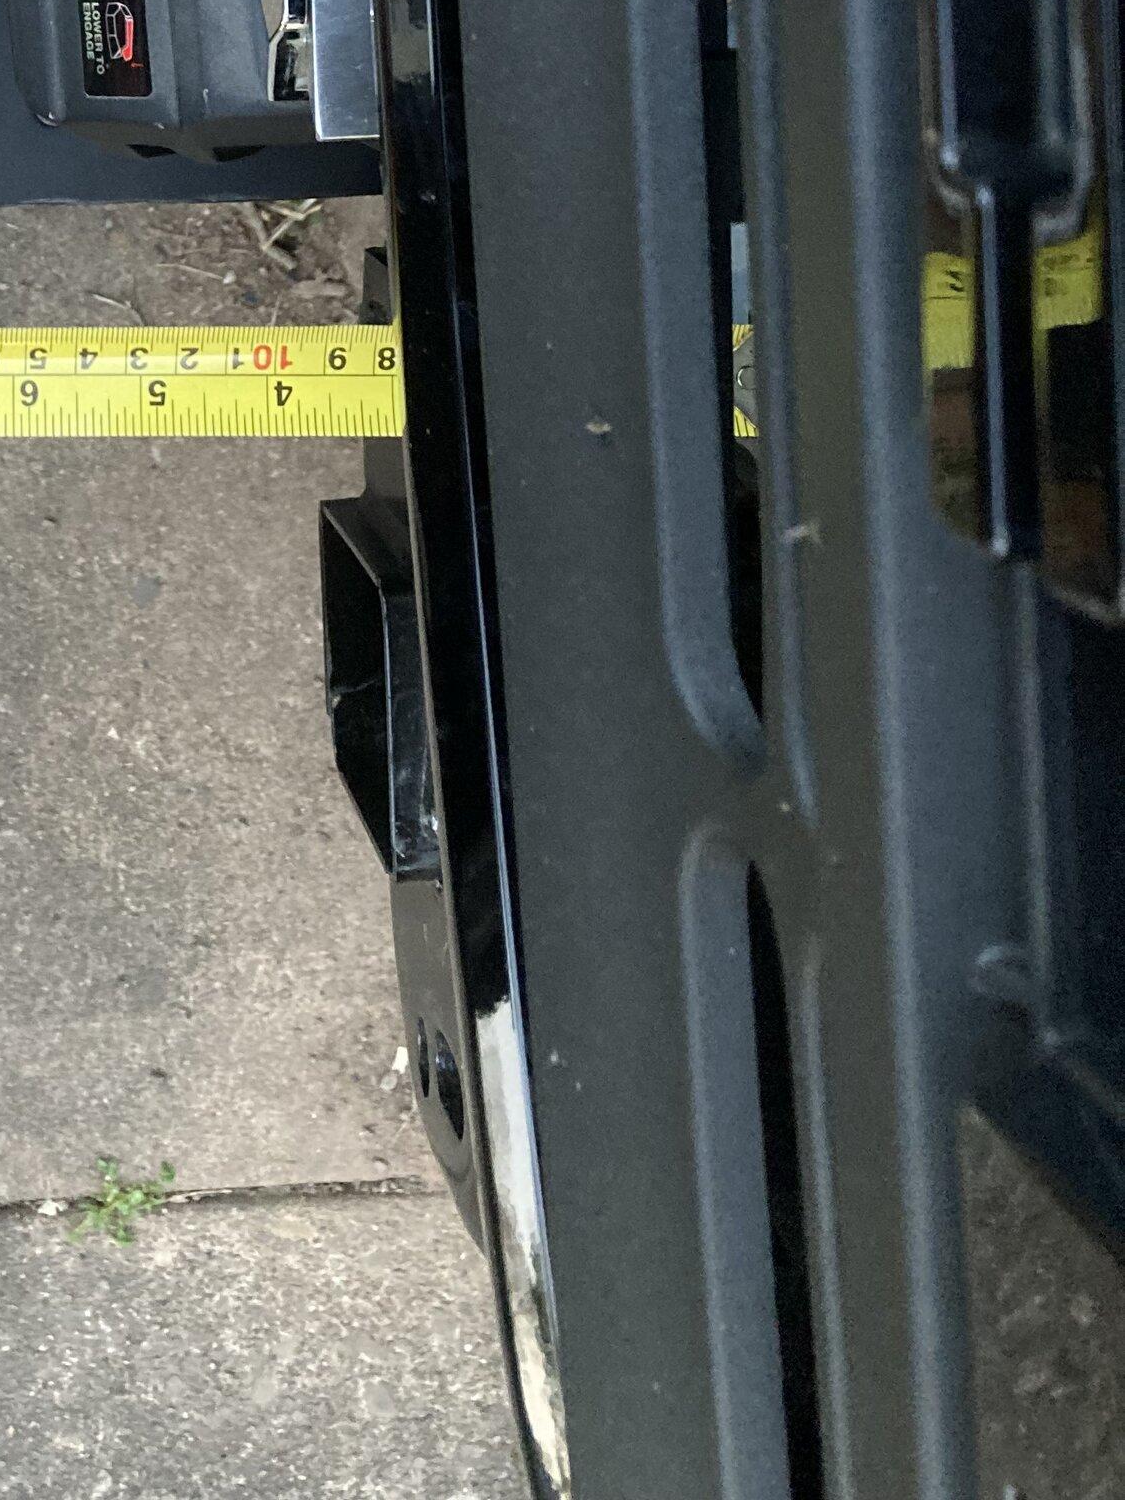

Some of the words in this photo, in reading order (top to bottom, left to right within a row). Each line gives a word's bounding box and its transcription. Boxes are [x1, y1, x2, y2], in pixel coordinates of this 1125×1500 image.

[82, 2, 95, 61] ENGAGE
[91, 2, 103, 52] LOWER
[96, 55, 105, 75] TO
[29, 348, 48, 369] 5
[79, 348, 98, 369] 4
[130, 347, 149, 369] 3
[180, 347, 199, 370] 2
[233, 348, 244, 369] 1
[328, 347, 347, 370] 9
[378, 347, 396, 370] 8
[20, 380, 38, 406] 6
[148, 380, 167, 406] 5
[275, 381, 293, 406] 4
